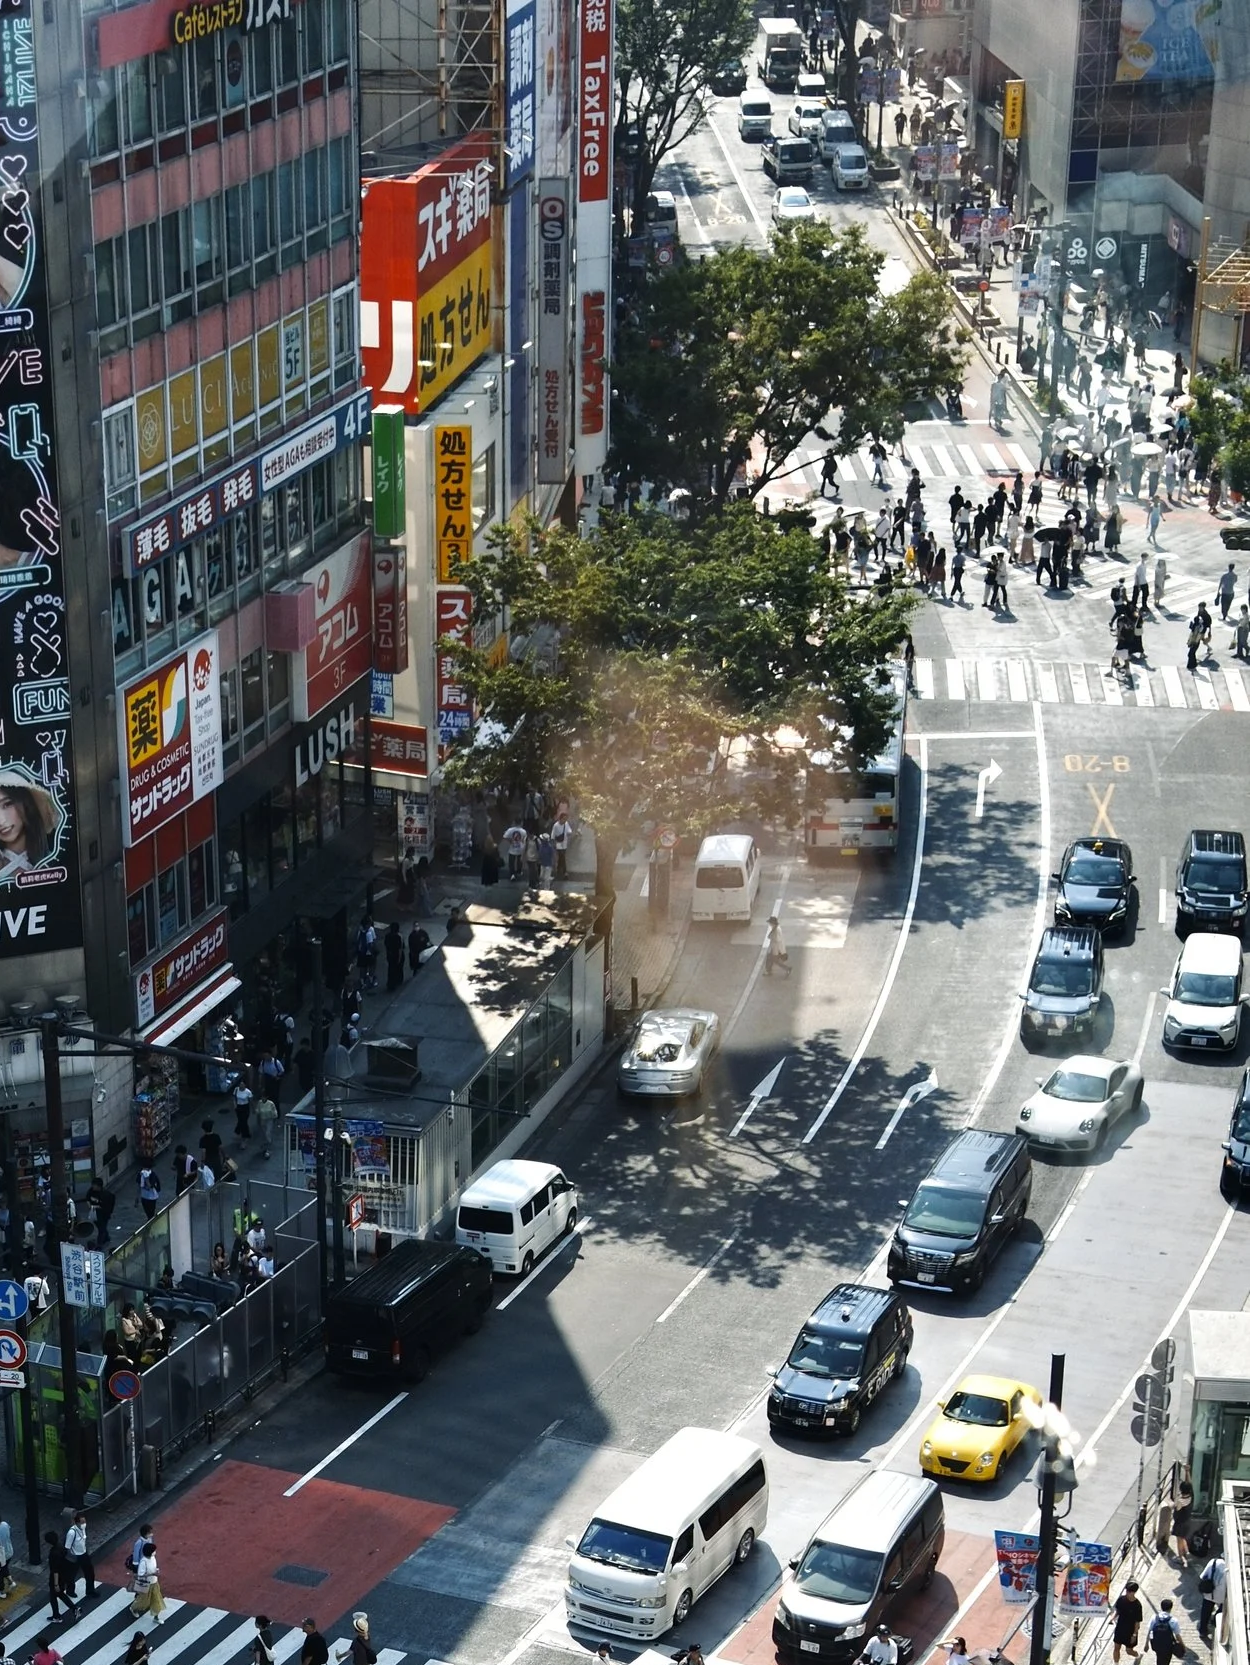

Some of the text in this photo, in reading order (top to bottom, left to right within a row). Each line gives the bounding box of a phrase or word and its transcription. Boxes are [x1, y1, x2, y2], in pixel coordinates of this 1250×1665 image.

[1160, 51, 1190, 63] TEA
[1161, 38, 1190, 50] ICE
[583, 55, 606, 177] TaxFree
[417, 157, 492, 274] スギ薬局
[419, 267, 492, 392] 処方せん
[285, 346, 300, 380] 5F
[343, 395, 369, 440] 4F
[377, 455, 390, 494] レイク
[439, 430, 467, 539] 処方せん
[136, 518, 171, 565] 薄毛
[180, 493, 214, 539] 抜毛
[223, 468, 254, 513] 発毛
[13, 610, 27, 645] HAVE
[317, 601, 360, 664] アコム
[378, 602, 394, 649] アコム
[332, 659, 347, 691] 3F
[372, 679, 393, 696] 時間
[130, 690, 159, 761] 薬
[197, 722, 211, 738] Shop
[439, 710, 455, 728] 24
[130, 768, 150, 792] DRUG
[150, 764, 157, 778] &
[156, 741, 190, 775] COSMETIC
[193, 732, 220, 756] SUNDRUG
[294, 701, 356, 789] LUSH
[1061, 753, 1132, 773] 8-20
[130, 762, 192, 826] サンドラッグ
[175, 922, 225, 979] サンドラッグ
[71, 1248, 85, 1302] 渋谷駅前
